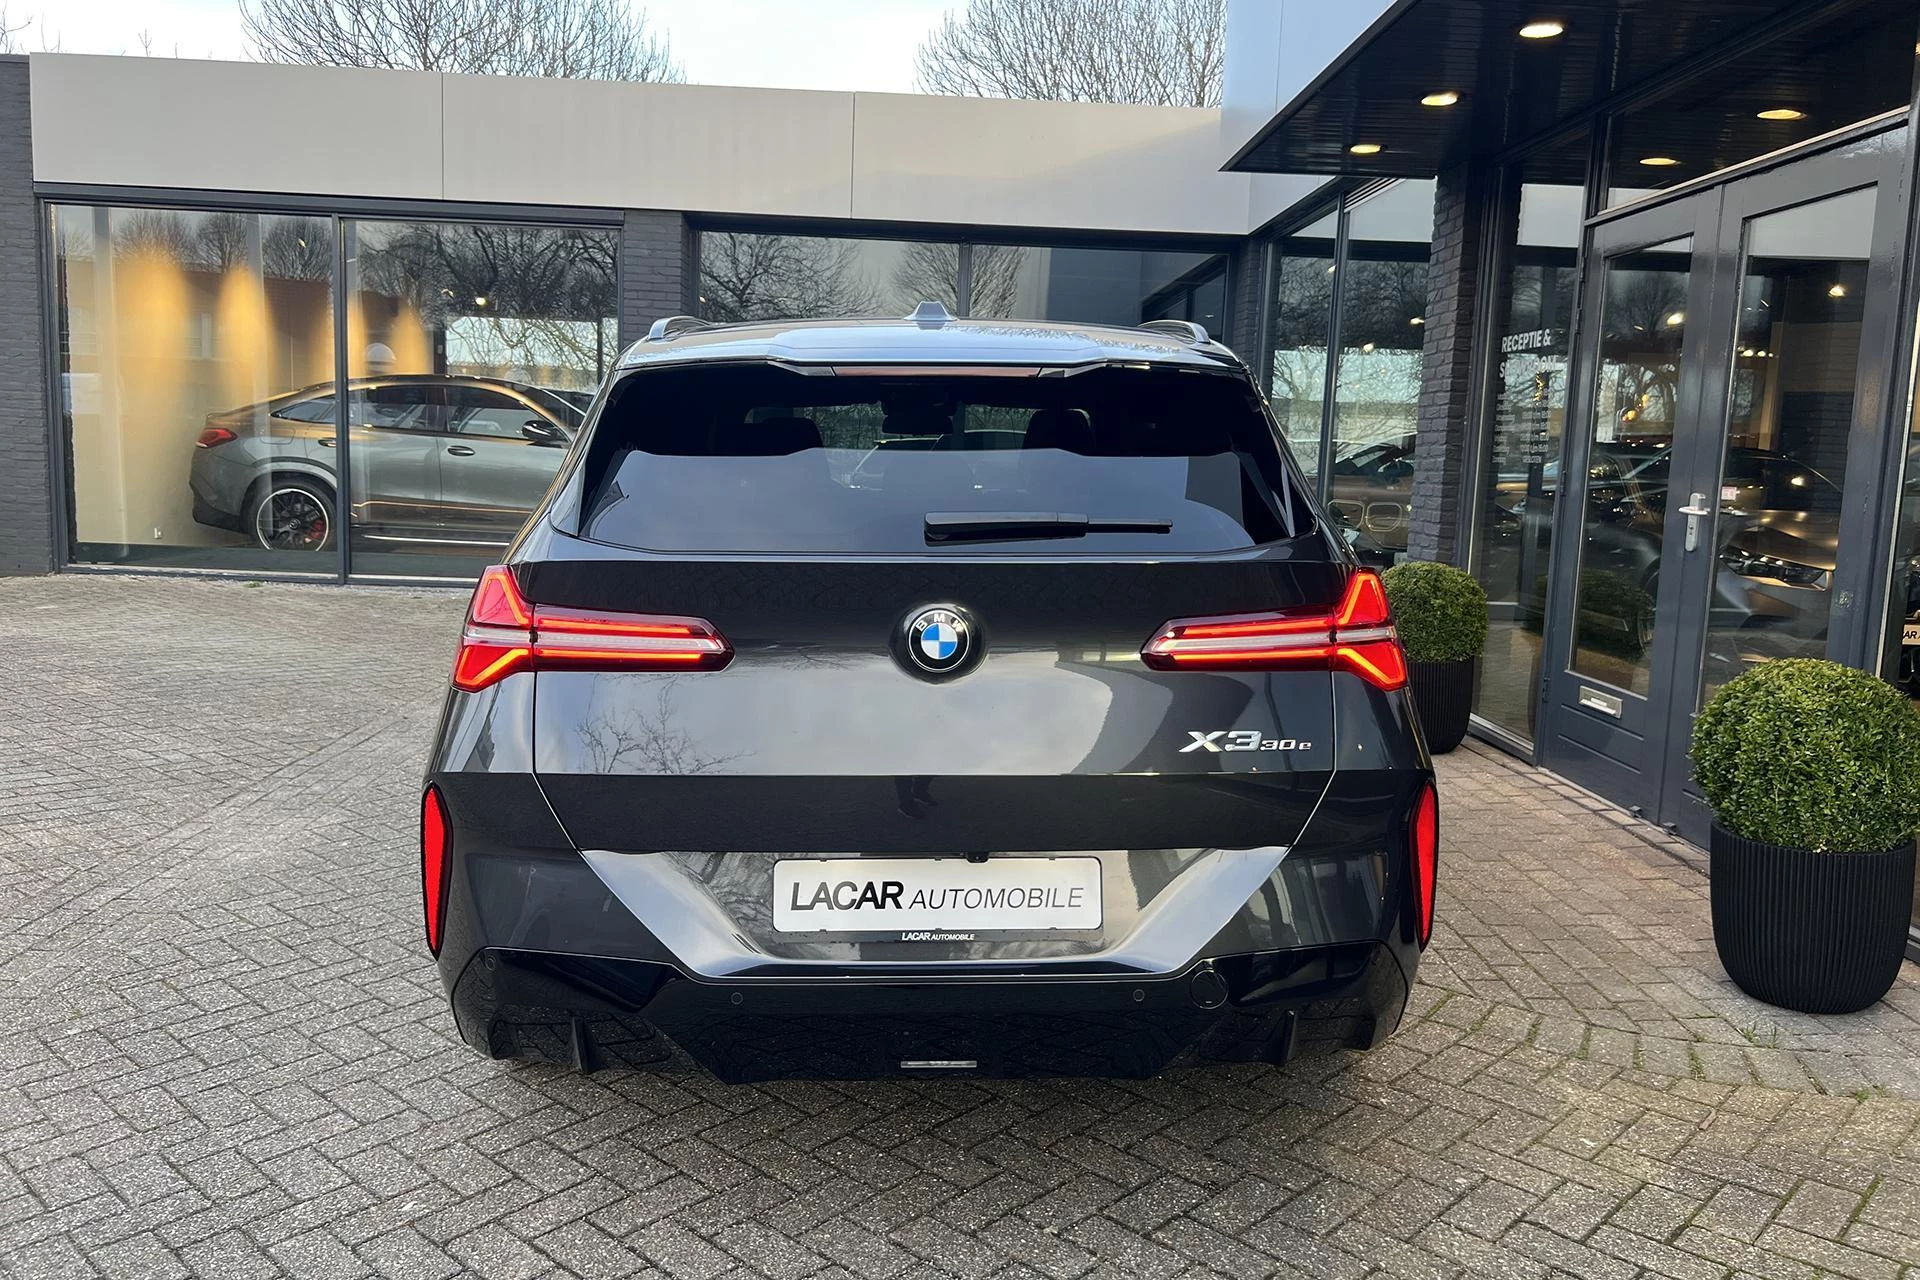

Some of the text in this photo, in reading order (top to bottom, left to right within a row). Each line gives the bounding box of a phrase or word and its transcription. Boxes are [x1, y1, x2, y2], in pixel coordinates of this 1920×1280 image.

[1501, 329, 1551, 352] RECEPTIE &
[915, 613, 964, 632] BMW
[1179, 731, 1262, 752] X3
[790, 881, 1084, 911] LACAR AUTOMOBILE
[902, 932, 931, 941] LACAR
